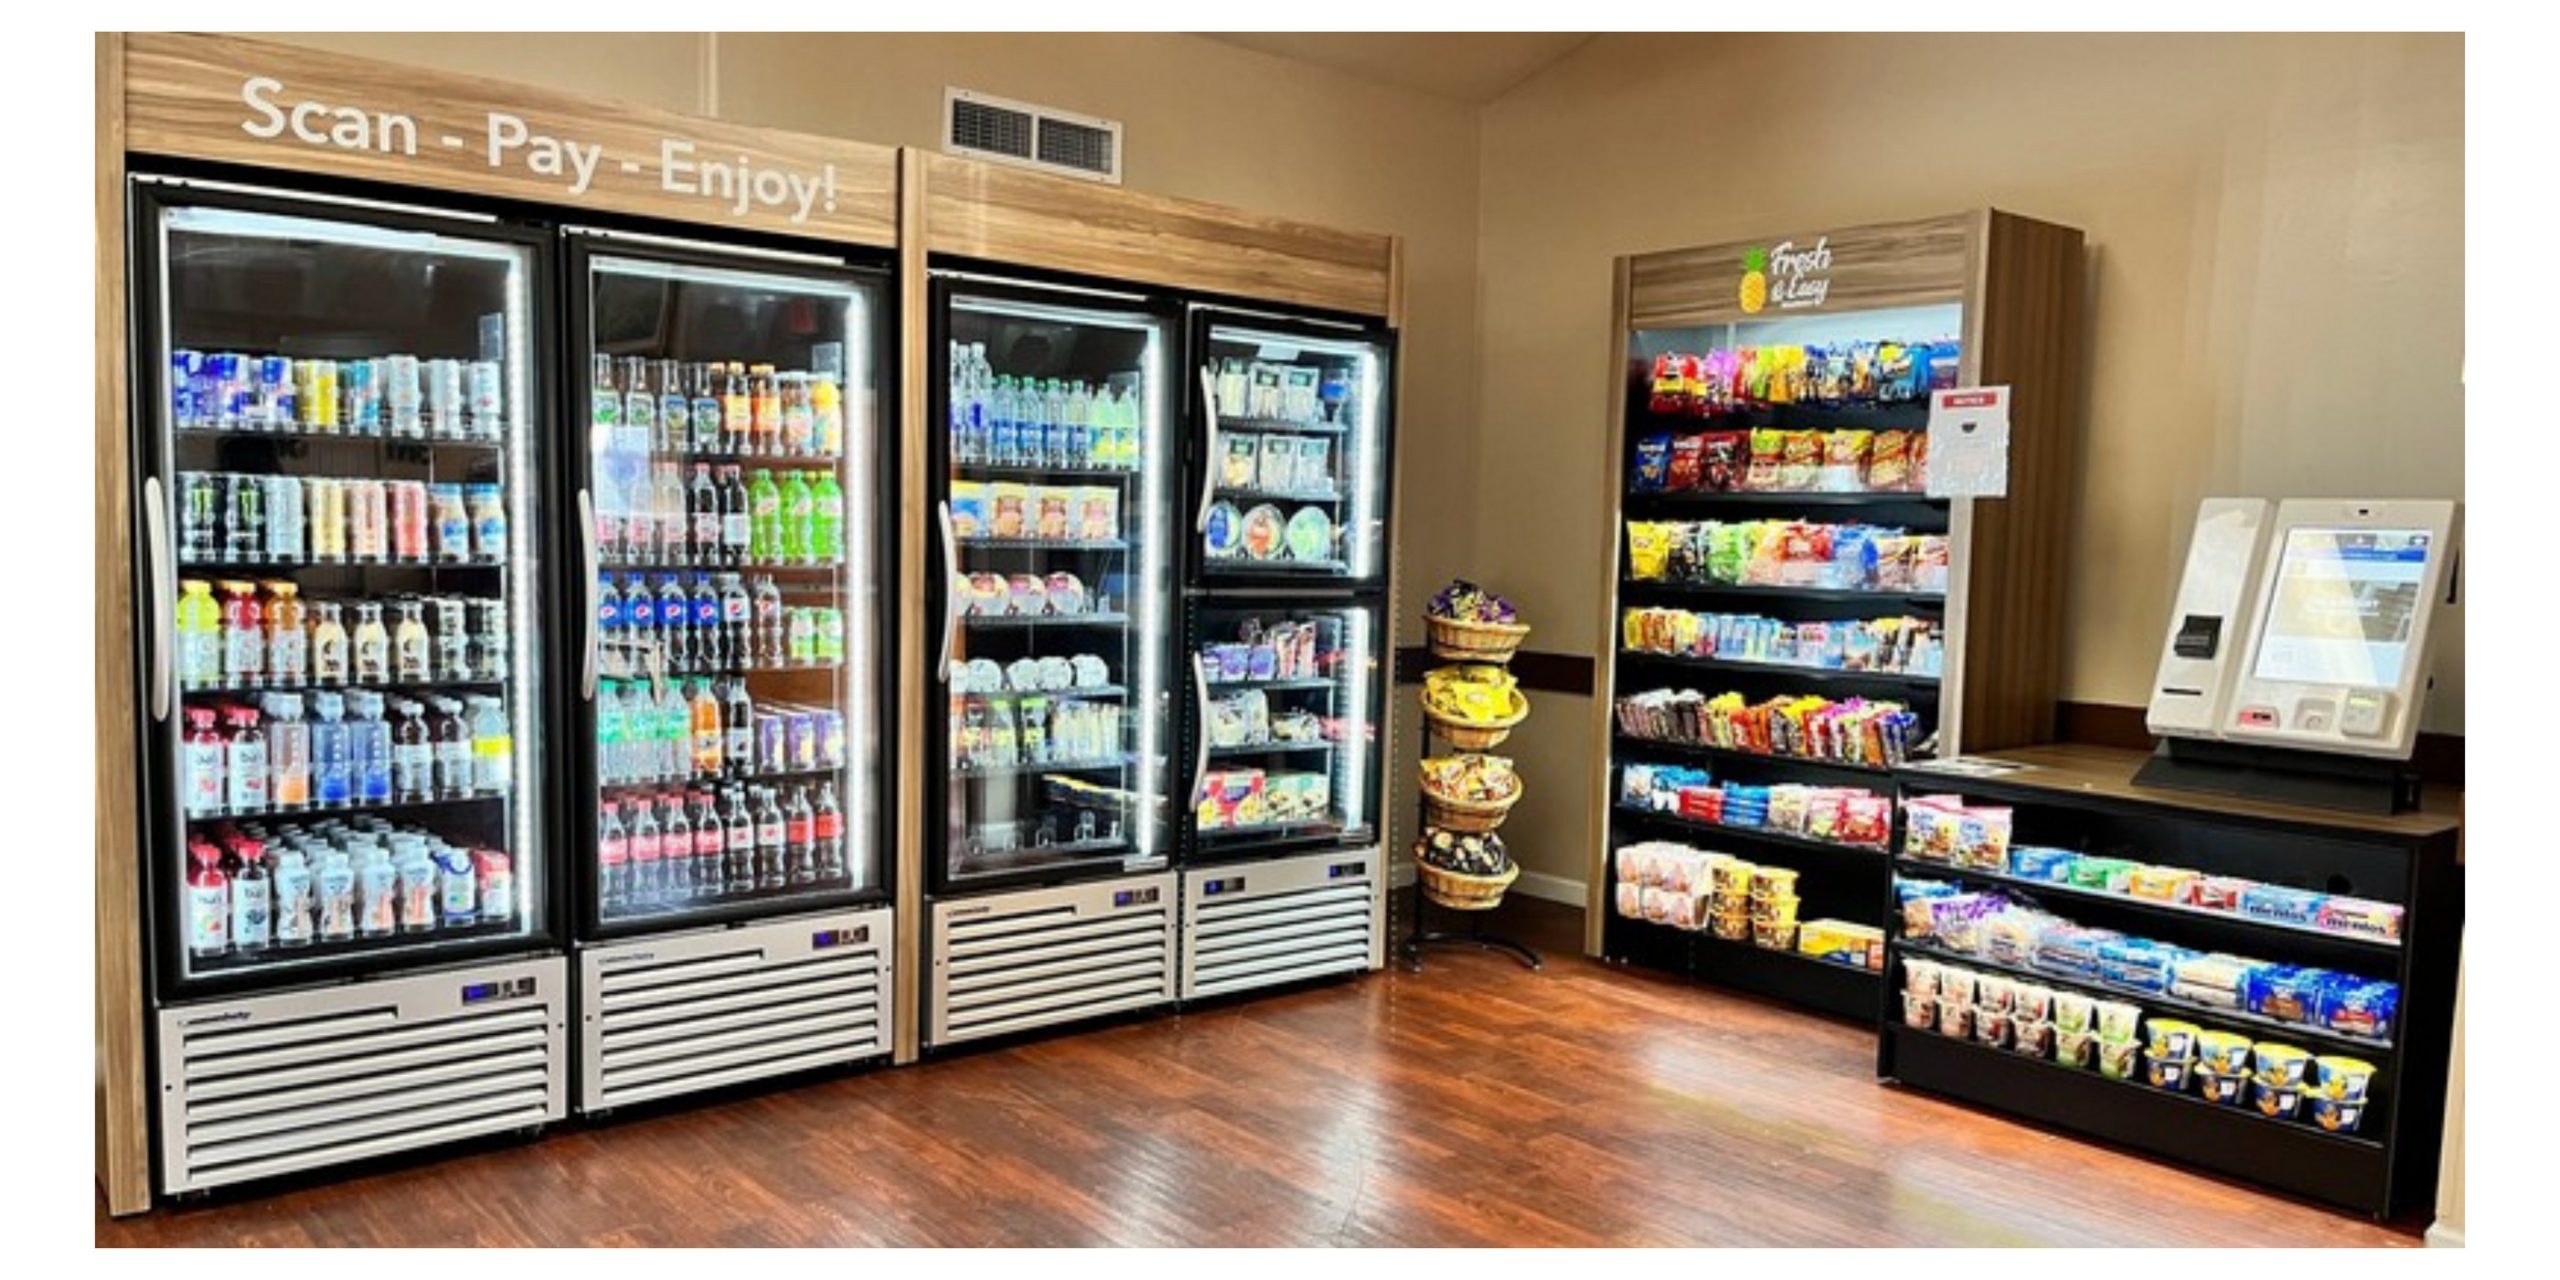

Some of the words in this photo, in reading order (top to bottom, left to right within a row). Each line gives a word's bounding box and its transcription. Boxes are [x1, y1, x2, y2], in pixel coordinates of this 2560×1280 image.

[242, 77, 417, 155] Scan
[441, 135, 464, 148] -
[488, 112, 602, 195] Pay
[619, 161, 641, 173] -
[661, 138, 836, 224] Enjoy!
[1770, 236, 1831, 276] Fresh
[2249, 905, 2307, 923] mentos
[2326, 918, 2386, 935] mentos
